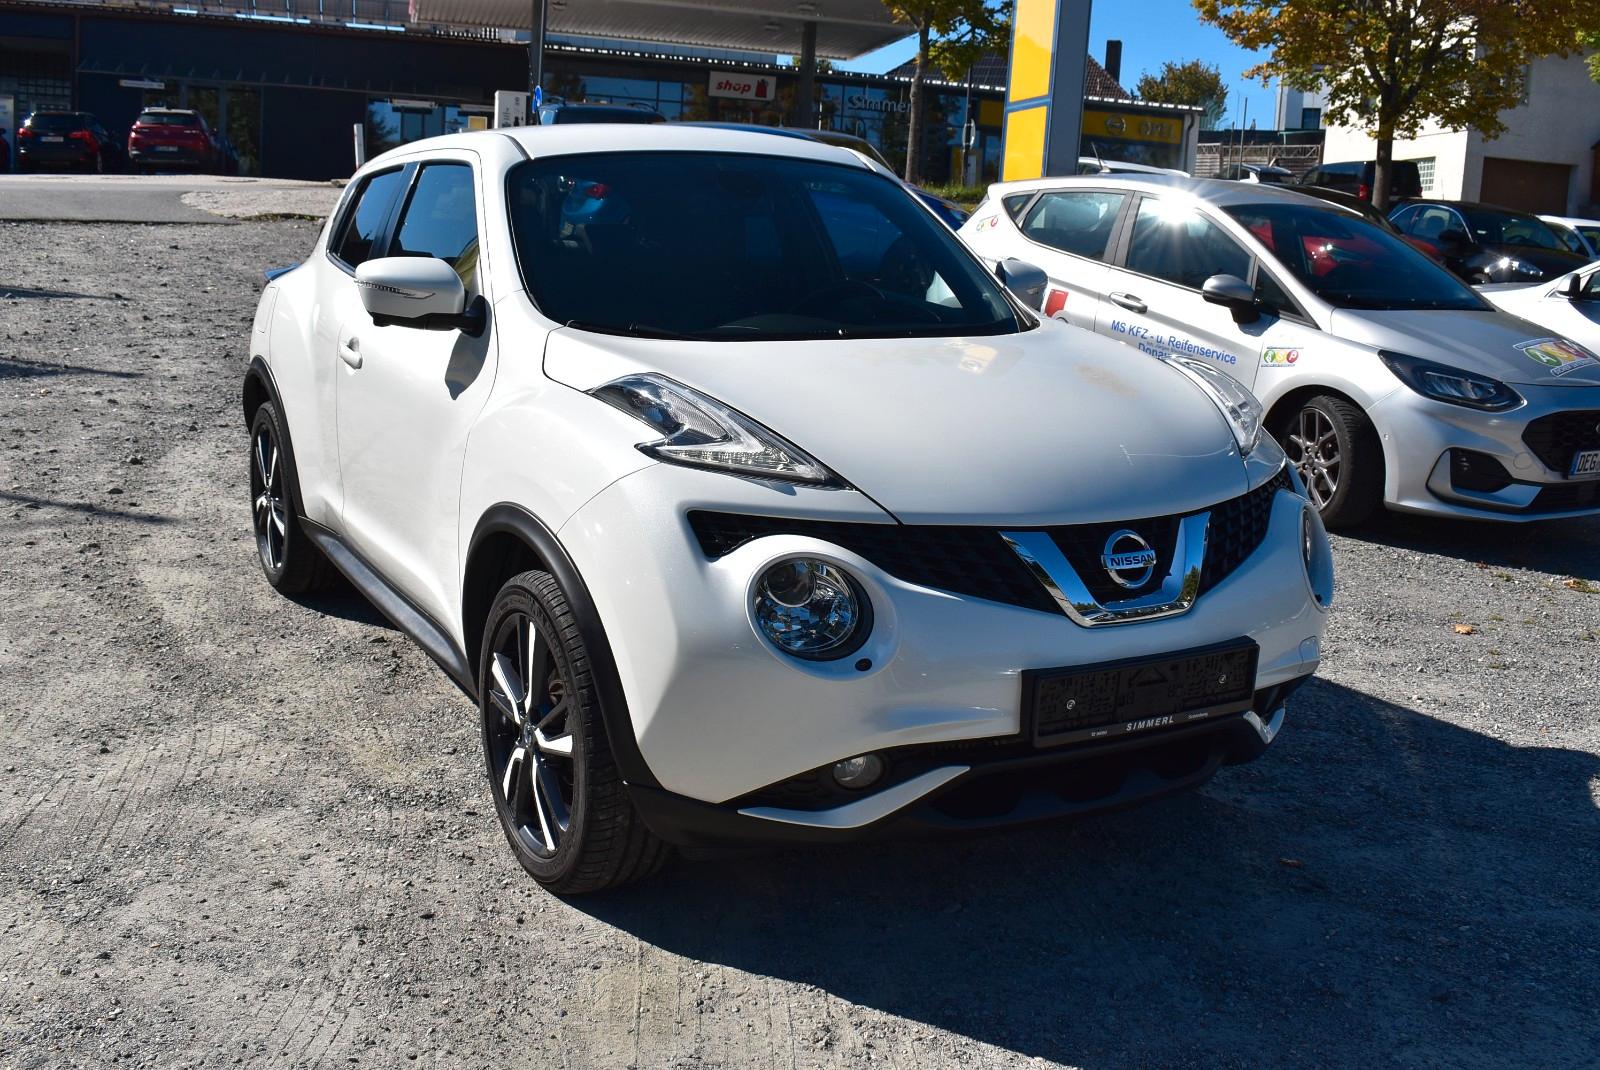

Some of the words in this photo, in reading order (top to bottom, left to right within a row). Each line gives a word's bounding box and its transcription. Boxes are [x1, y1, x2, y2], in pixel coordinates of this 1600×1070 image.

[716, 80, 752, 94] shop
[1111, 320, 1126, 333] MS
[1128, 324, 1149, 340] KFZ
[1168, 336, 1237, 365] Reifenservice
[1576, 453, 1599, 472] DEG
[1110, 553, 1154, 566] NISSAN
[1126, 715, 1175, 731] SIMMERL
